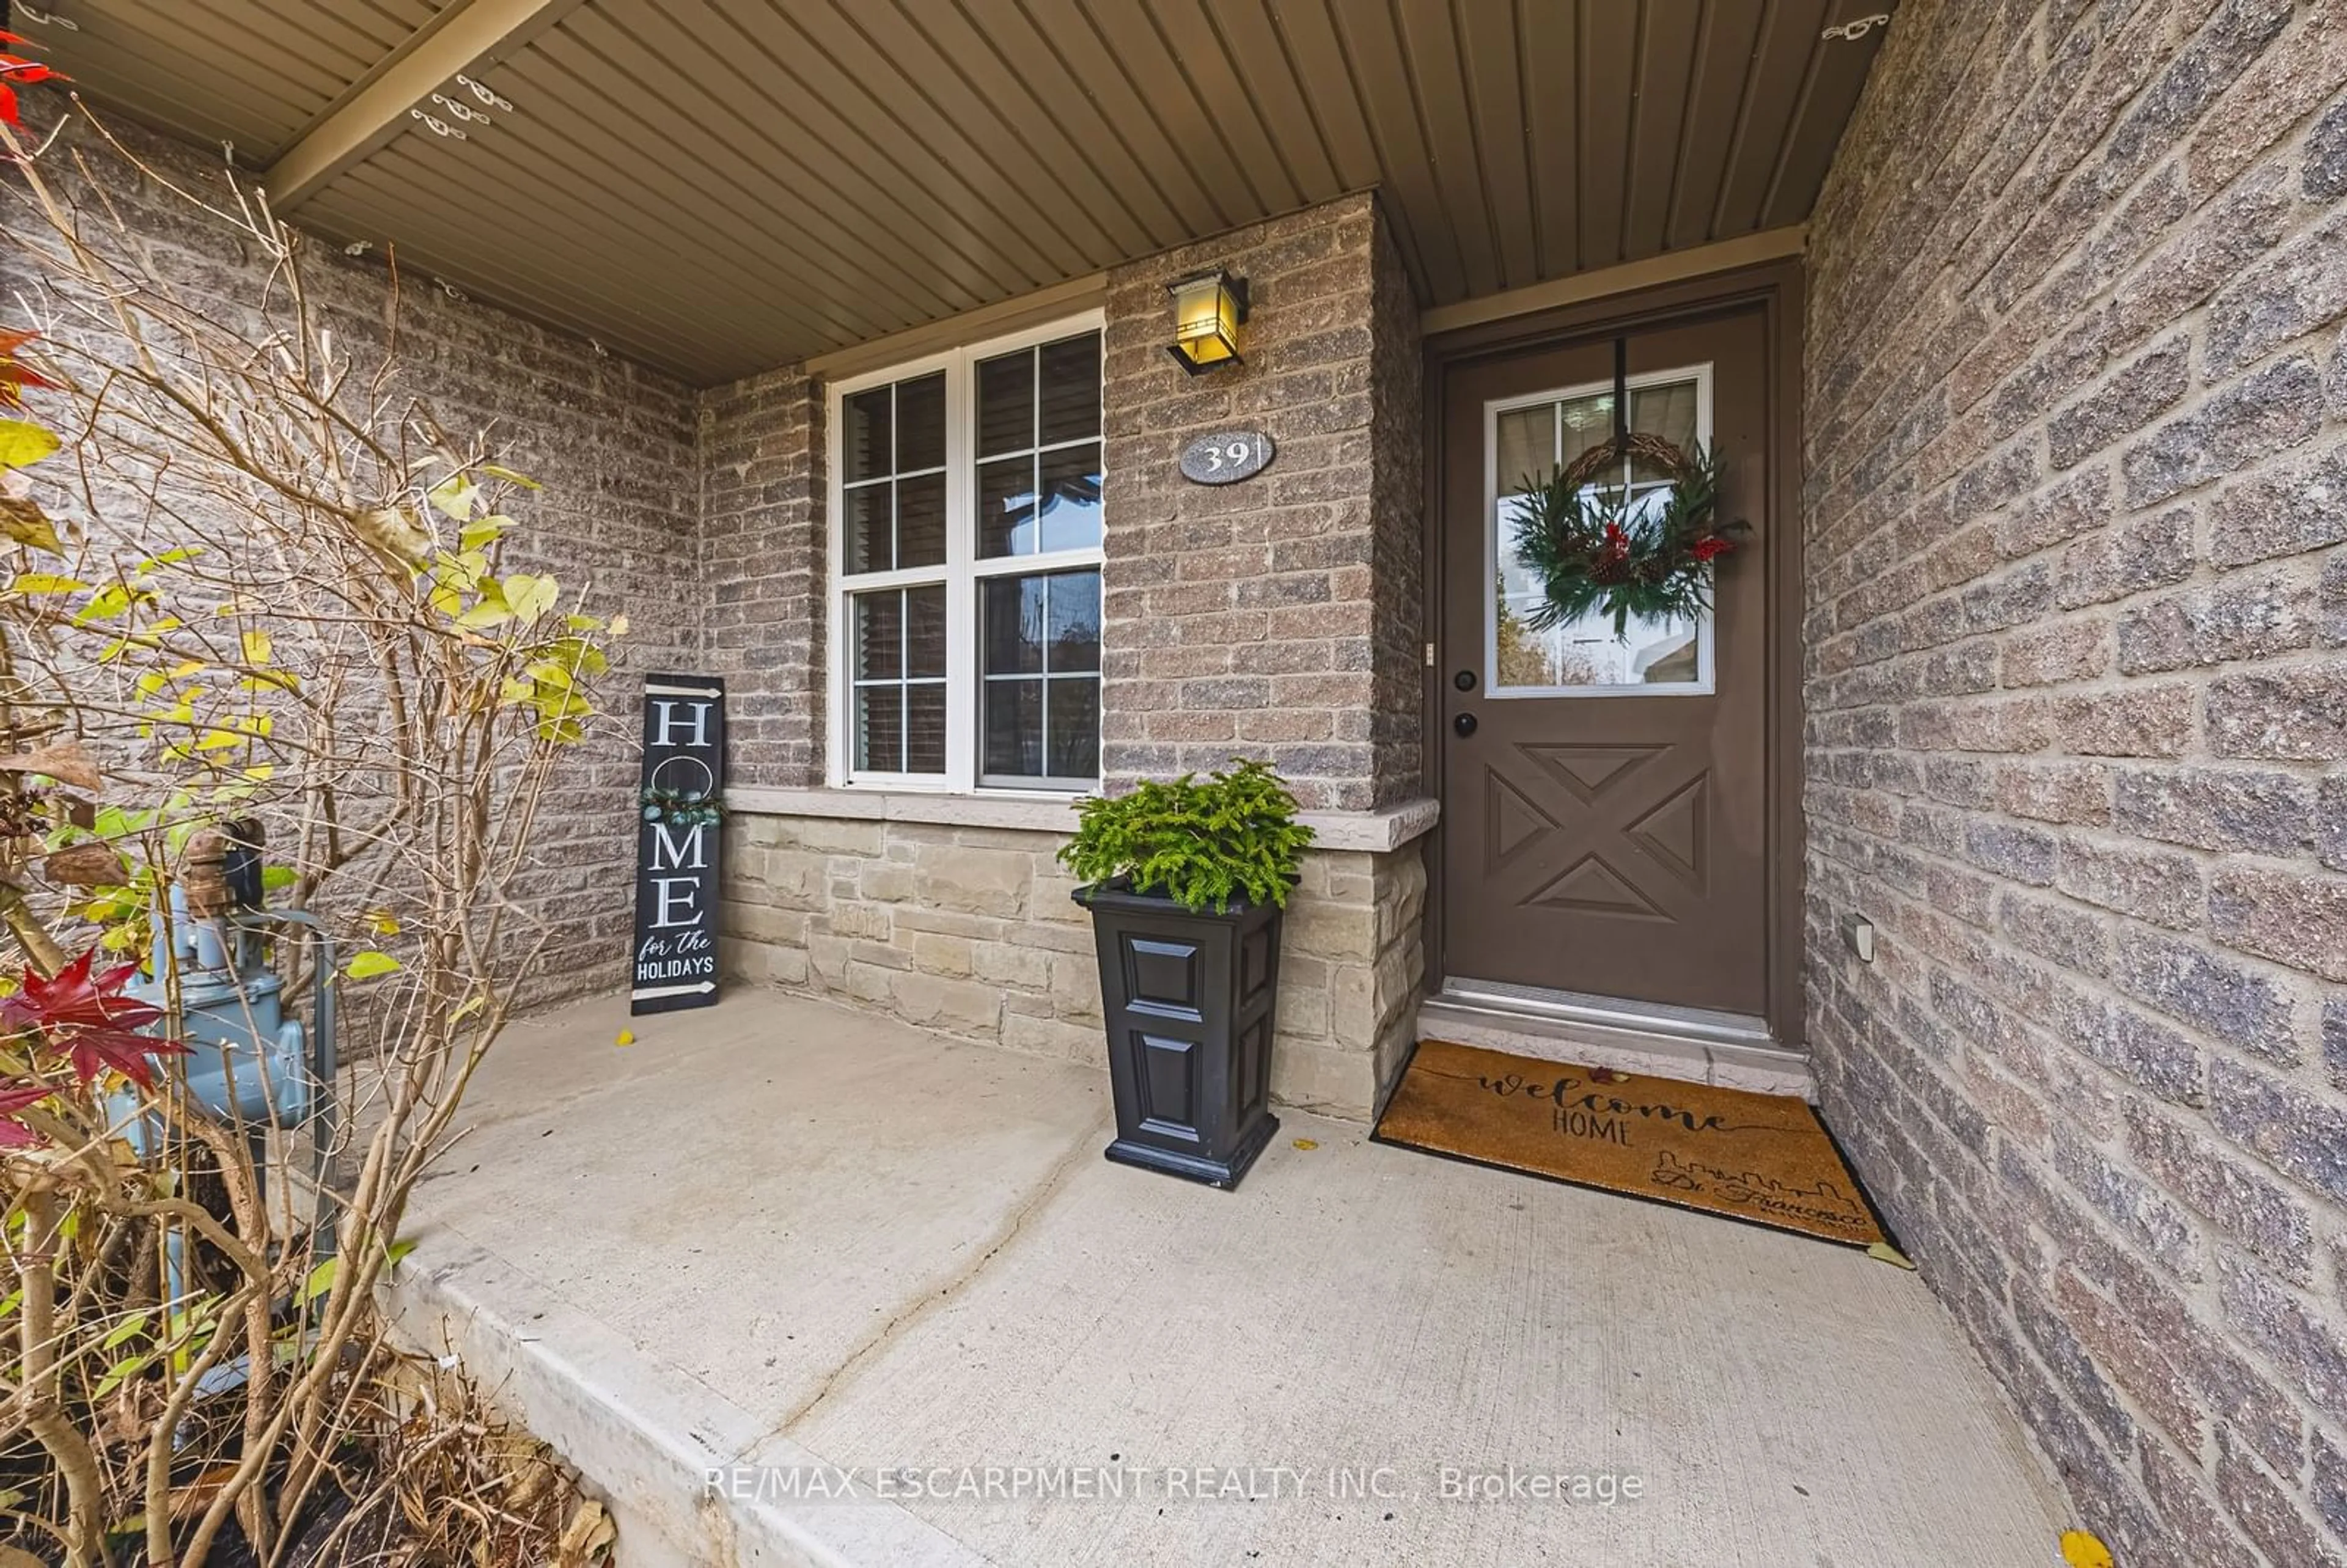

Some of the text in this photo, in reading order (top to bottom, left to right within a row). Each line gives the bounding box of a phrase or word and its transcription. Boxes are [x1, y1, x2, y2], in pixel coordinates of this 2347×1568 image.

[1204, 442, 1249, 472] 39
[648, 700, 714, 929] HOME
[639, 929, 711, 961] for the
[637, 956, 714, 981] HOLIDAYS
[1478, 1074, 1730, 1132] welcome
[1553, 1108, 1634, 1148] HOME
